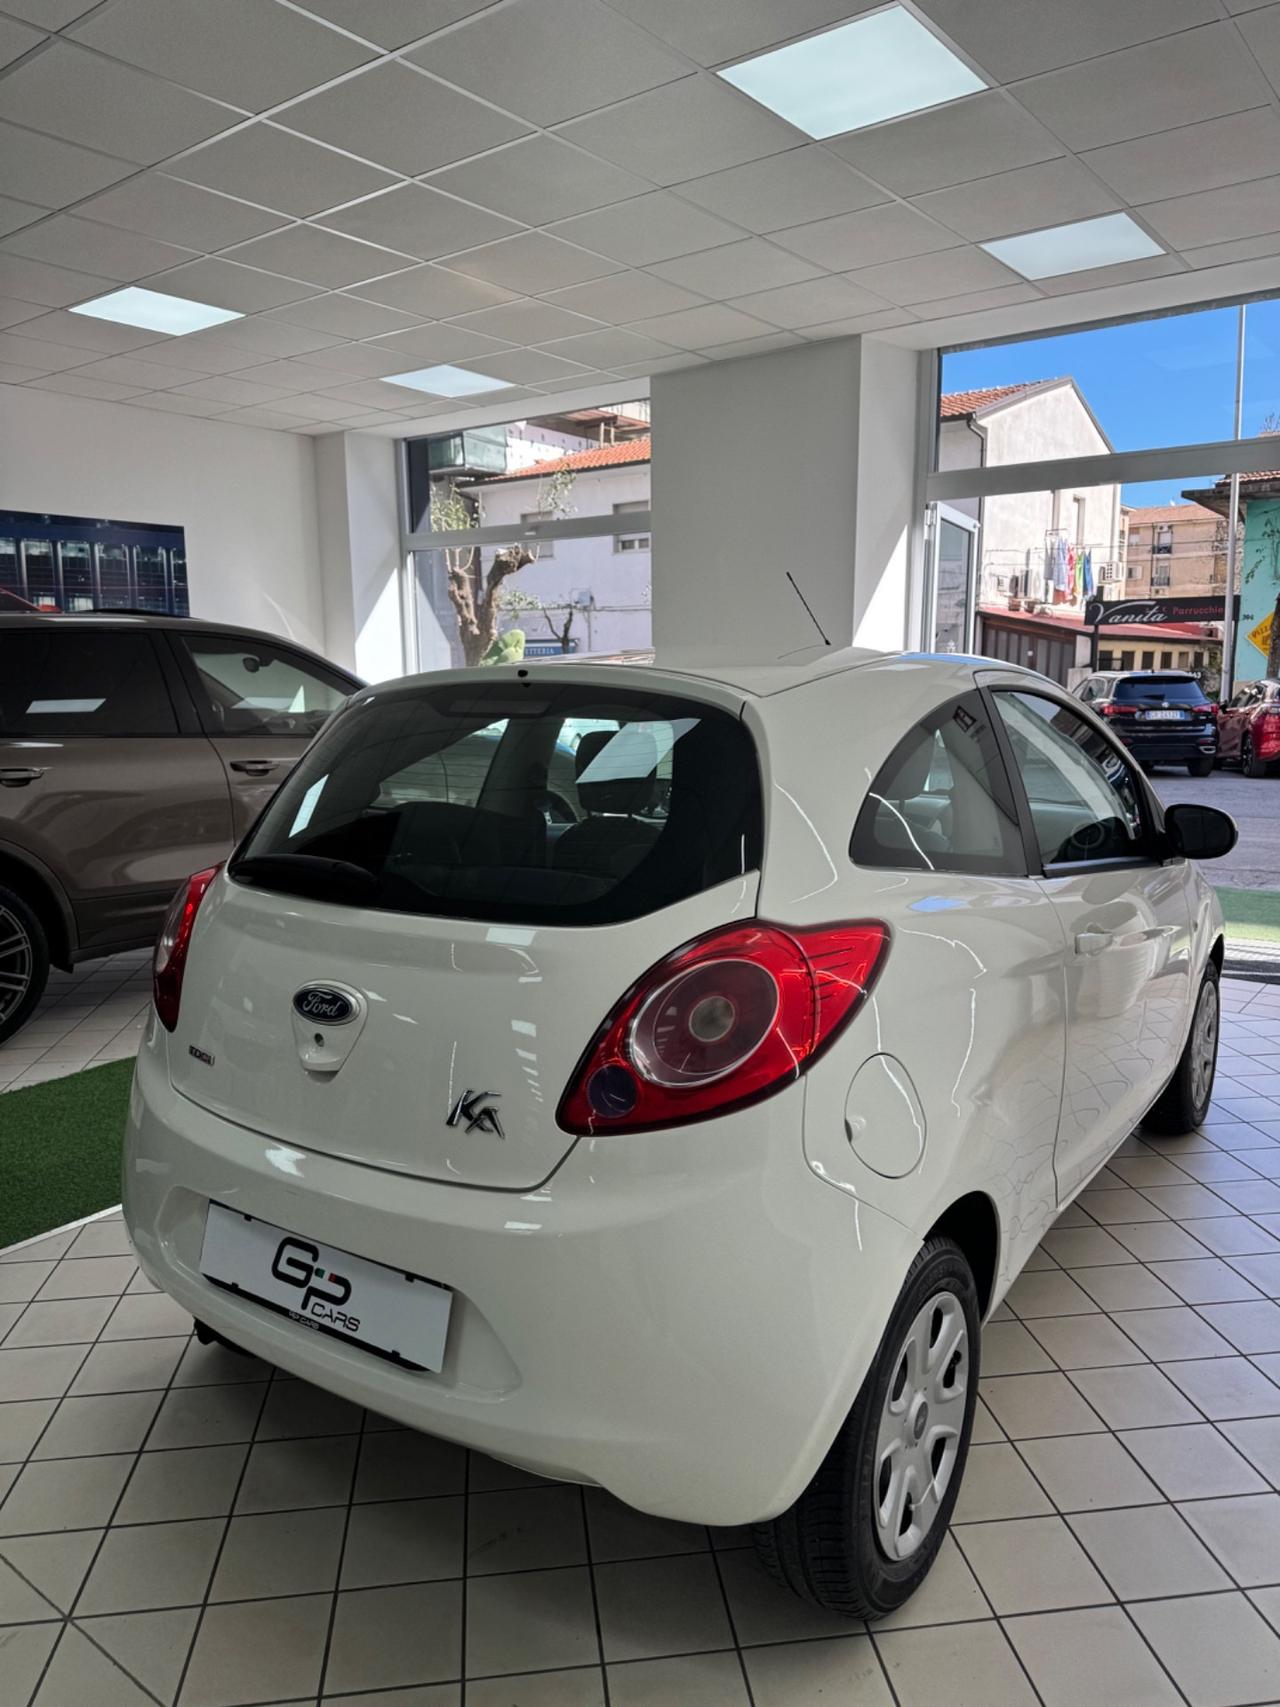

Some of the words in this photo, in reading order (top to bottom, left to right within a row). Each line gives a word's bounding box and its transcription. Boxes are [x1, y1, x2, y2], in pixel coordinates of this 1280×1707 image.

[1172, 606, 1224, 615] Parrucchie
[525, 647, 554, 655] ETTERIA
[302, 991, 342, 1017] Ford
[310, 1302, 361, 1332] CARS
